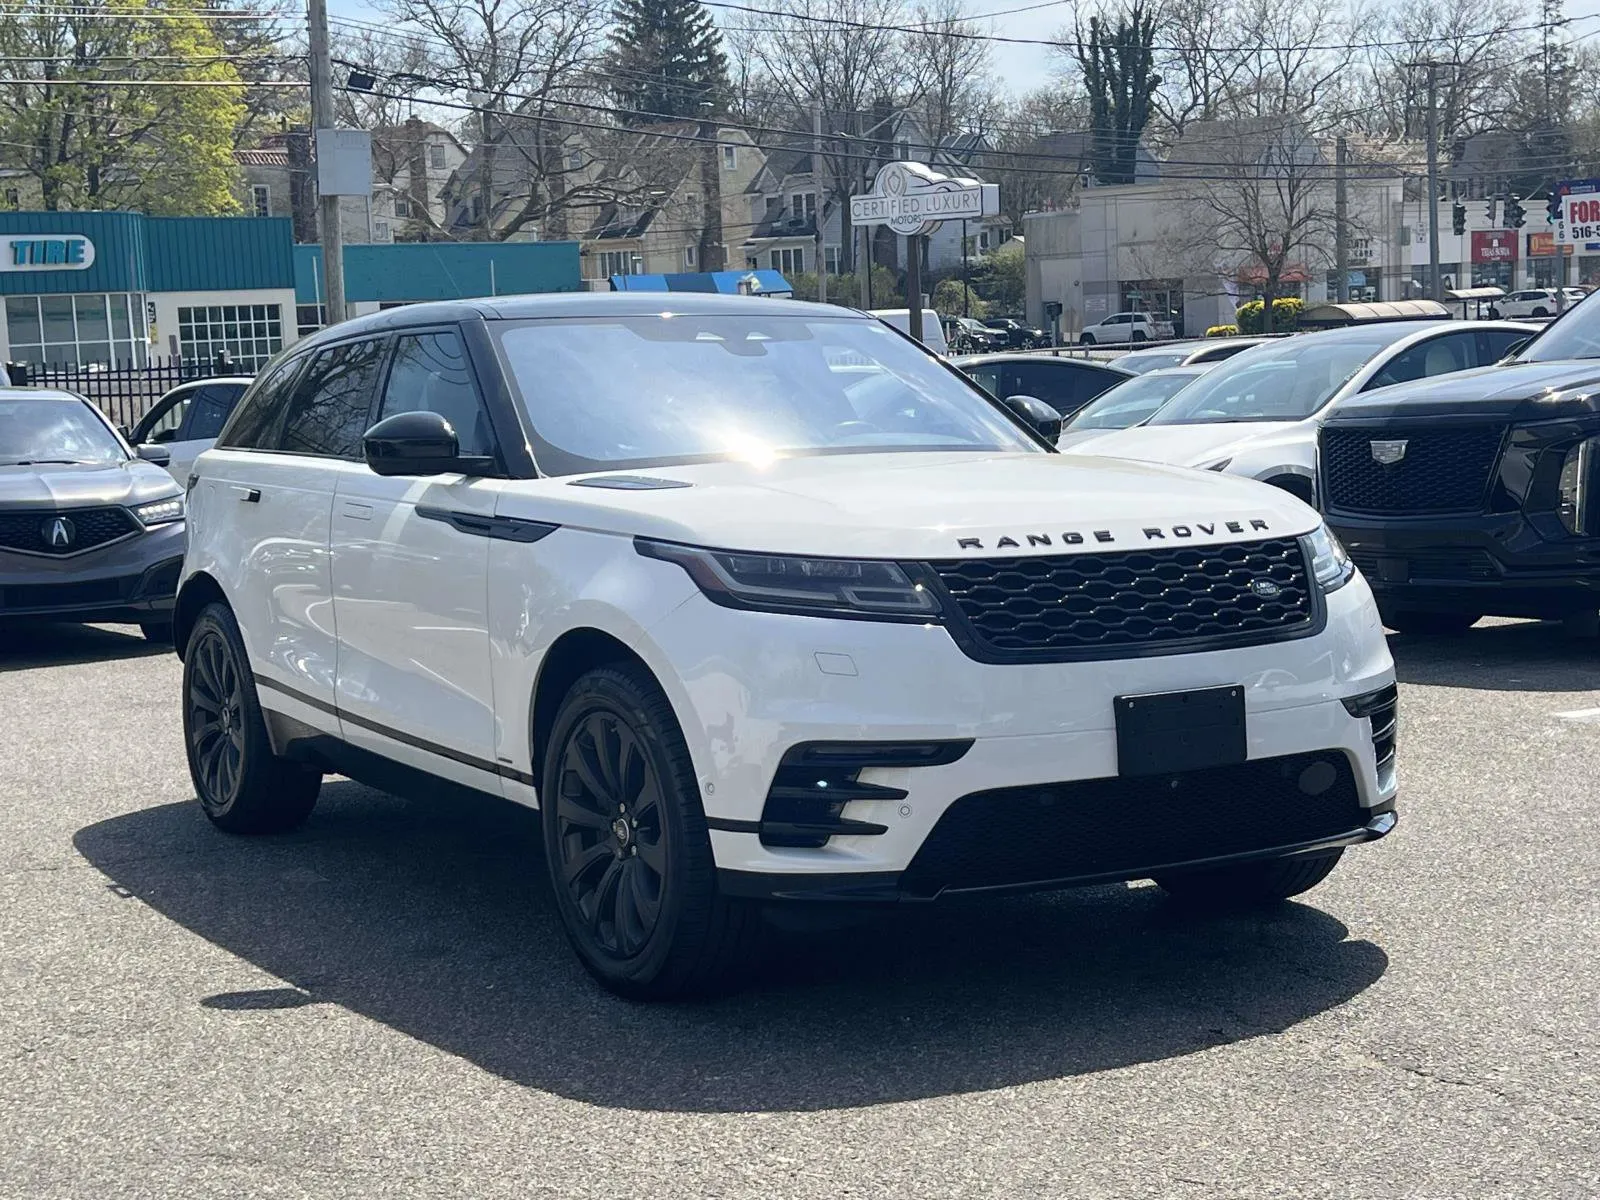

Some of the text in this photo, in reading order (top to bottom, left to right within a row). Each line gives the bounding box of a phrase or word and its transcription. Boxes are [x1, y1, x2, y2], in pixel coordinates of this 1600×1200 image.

[852, 192, 979, 217] CERTIFIED LUXURY
[1570, 200, 1600, 224] FOR
[890, 214, 923, 226] MOTORS
[10, 239, 86, 265] TIRE
[955, 518, 1271, 550] RANGE ROVER
